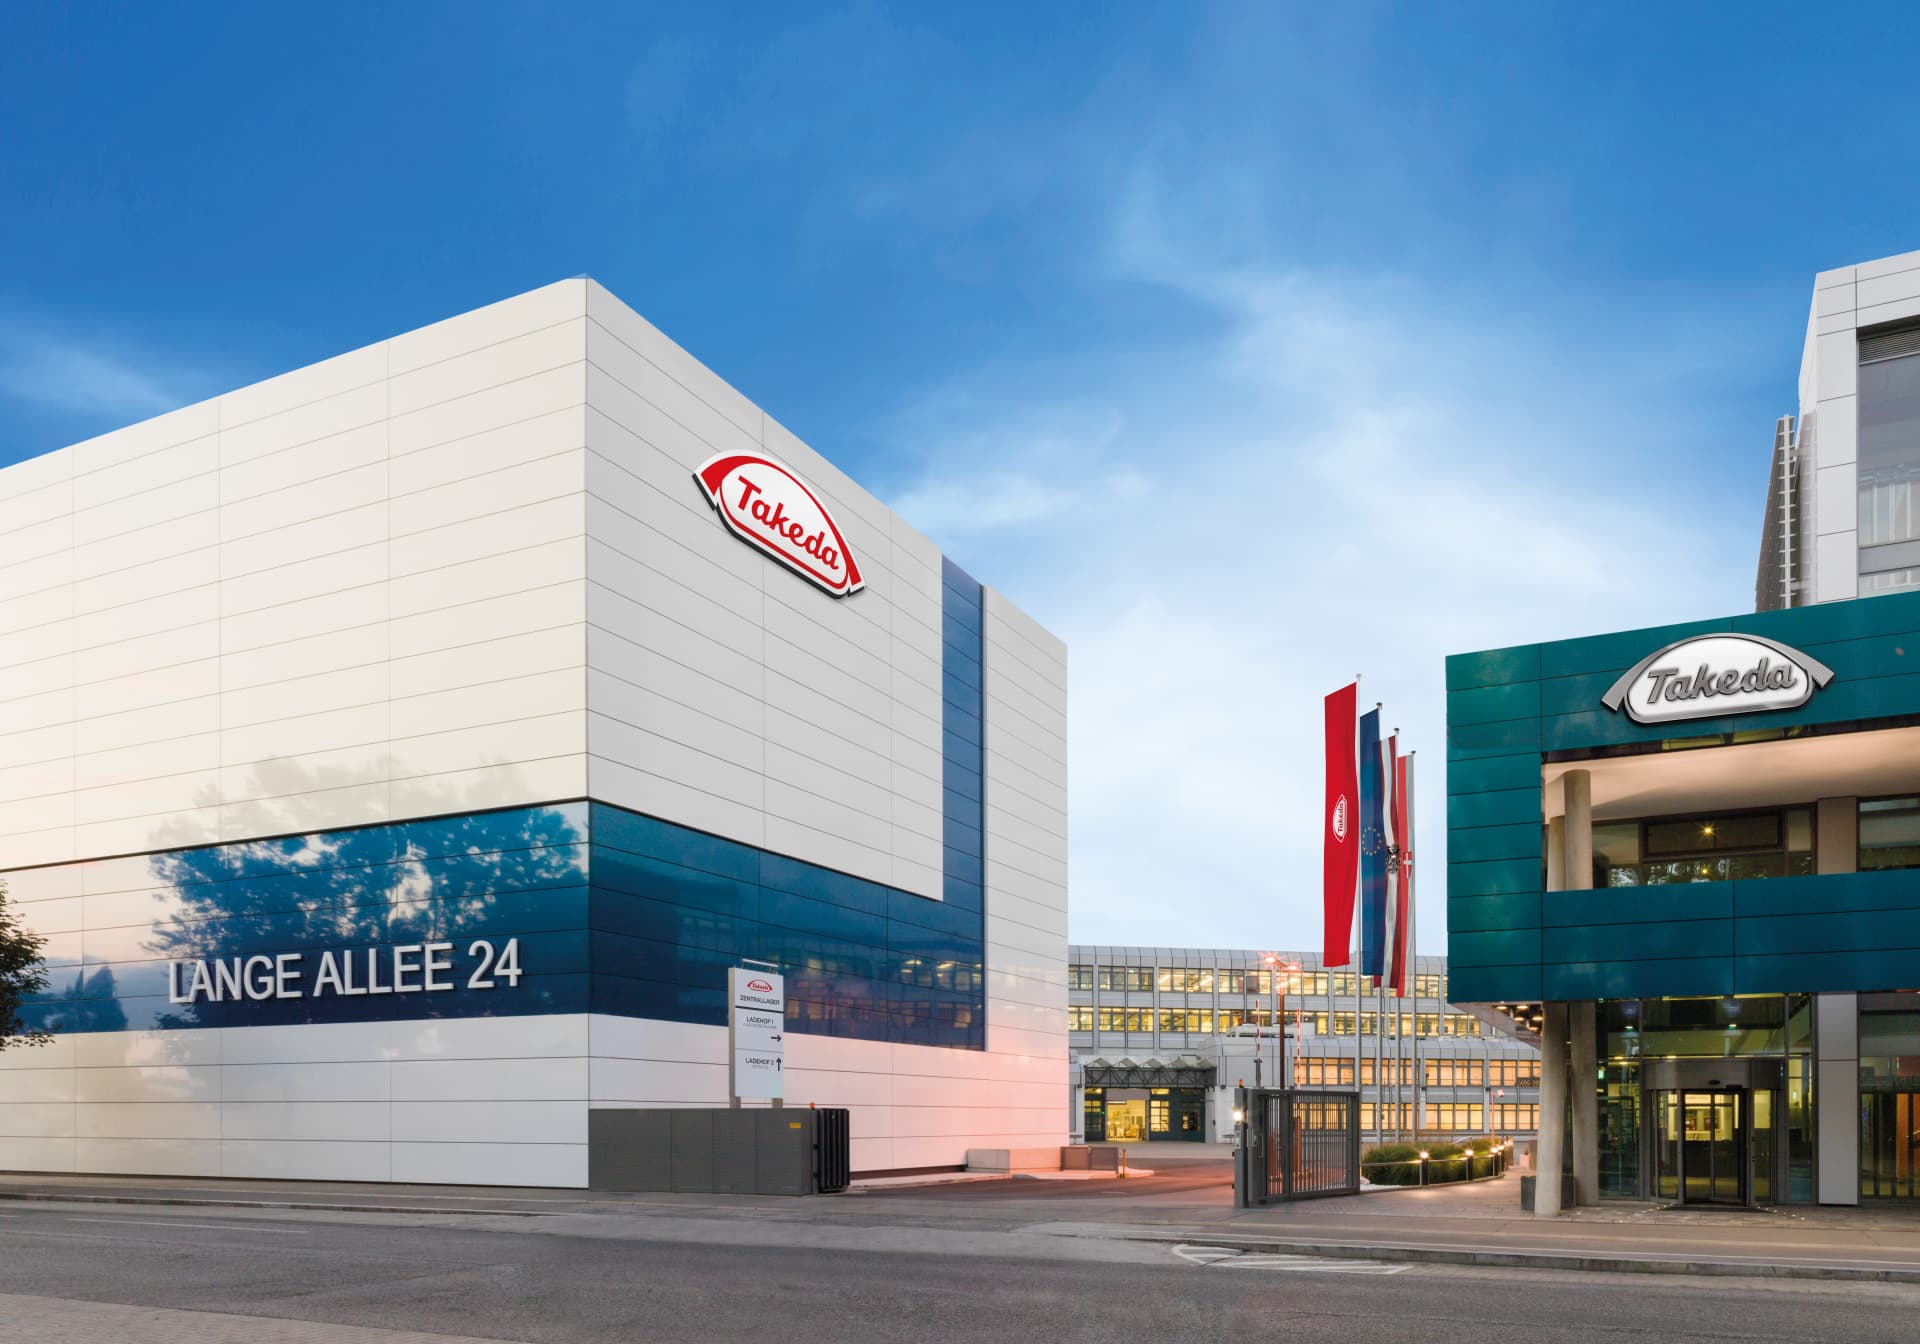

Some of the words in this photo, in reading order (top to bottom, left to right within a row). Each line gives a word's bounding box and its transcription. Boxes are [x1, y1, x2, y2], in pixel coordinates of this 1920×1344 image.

[737, 475, 839, 570] Takeda
[1647, 656, 1798, 704] Takeda
[169, 953, 303, 1004] LANGE
[313, 942, 454, 997] ALLEE
[468, 937, 523, 989] 24
[739, 994, 780, 1005] ZENTRALLAGER
[746, 1016, 771, 1024] LADEHOF
[745, 1057, 770, 1065] LADEHOF
